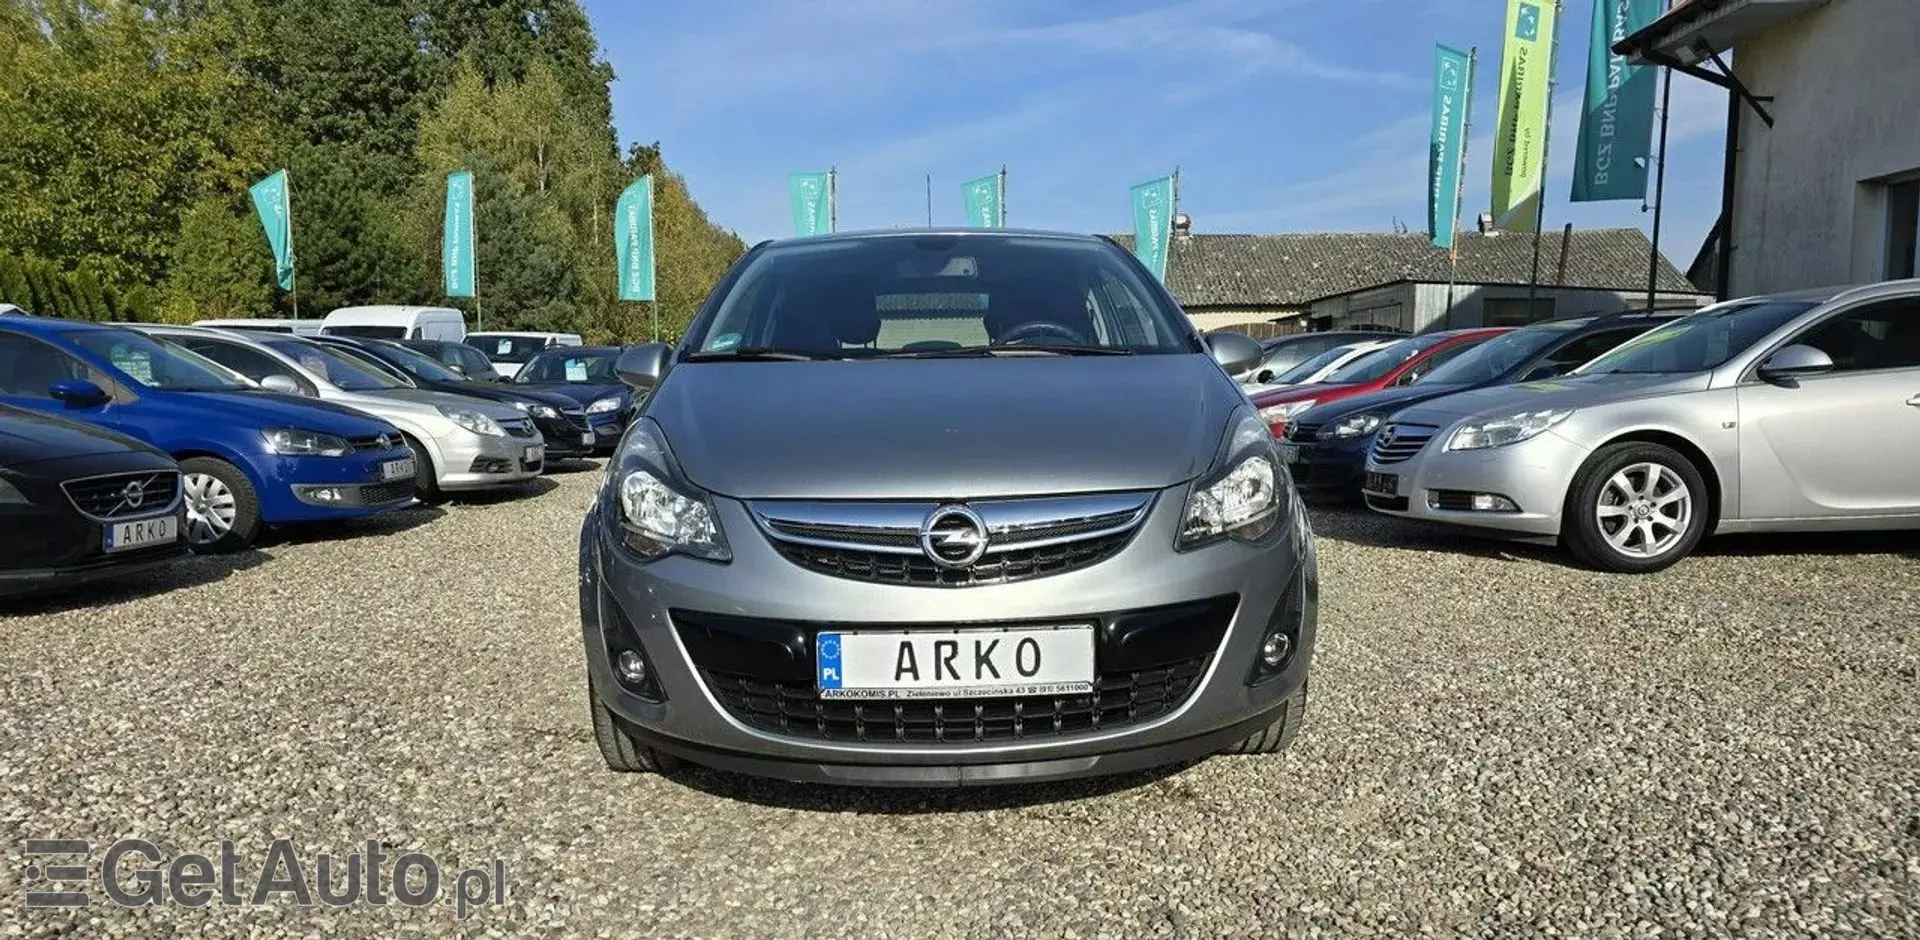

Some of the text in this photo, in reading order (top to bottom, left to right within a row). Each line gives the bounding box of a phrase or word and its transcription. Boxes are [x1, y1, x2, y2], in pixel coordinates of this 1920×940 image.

[122, 520, 167, 544] ARKO
[894, 637, 1041, 682] ARKO
[823, 667, 840, 681] PL
[824, 689, 901, 699] ARKOKOMIS.PL
